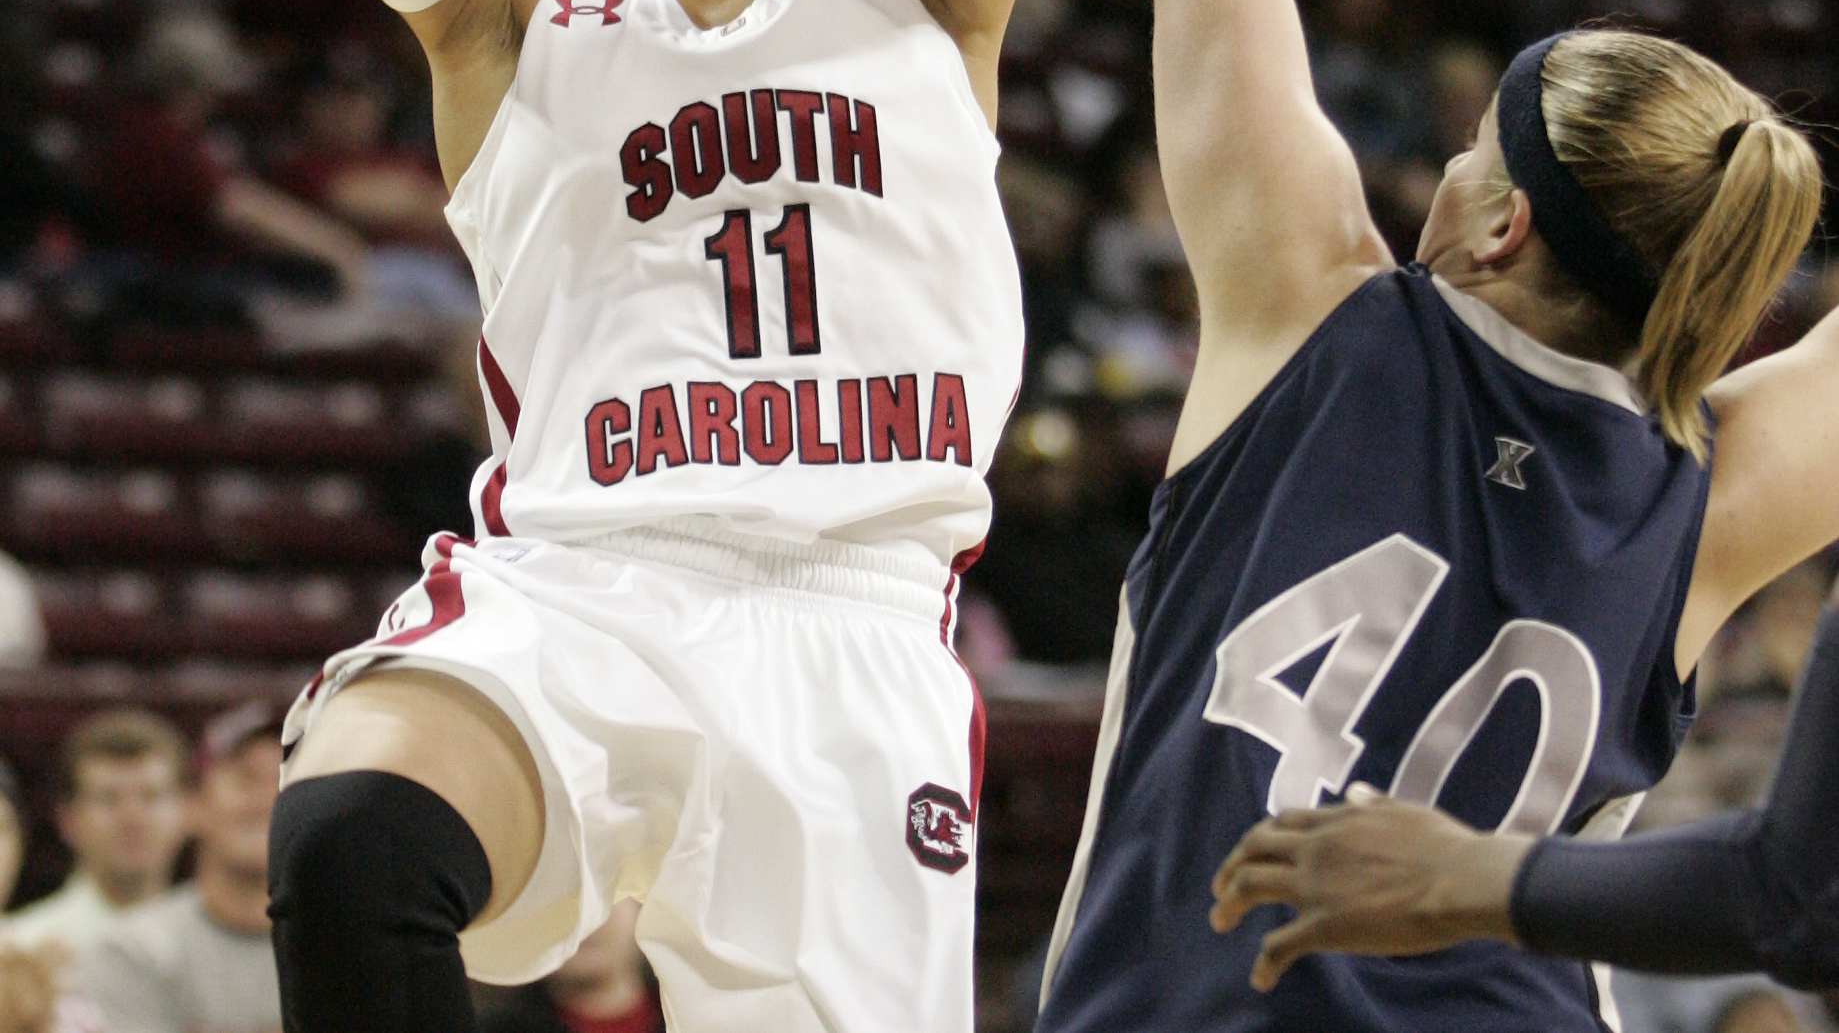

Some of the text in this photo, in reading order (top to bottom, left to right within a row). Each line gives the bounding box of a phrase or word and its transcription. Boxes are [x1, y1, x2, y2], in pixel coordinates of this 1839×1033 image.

[619, 88, 883, 223] SOUTH
[704, 203, 821, 359] 11
[584, 372, 973, 487] CAROLINA
[1202, 533, 1601, 837] 40
